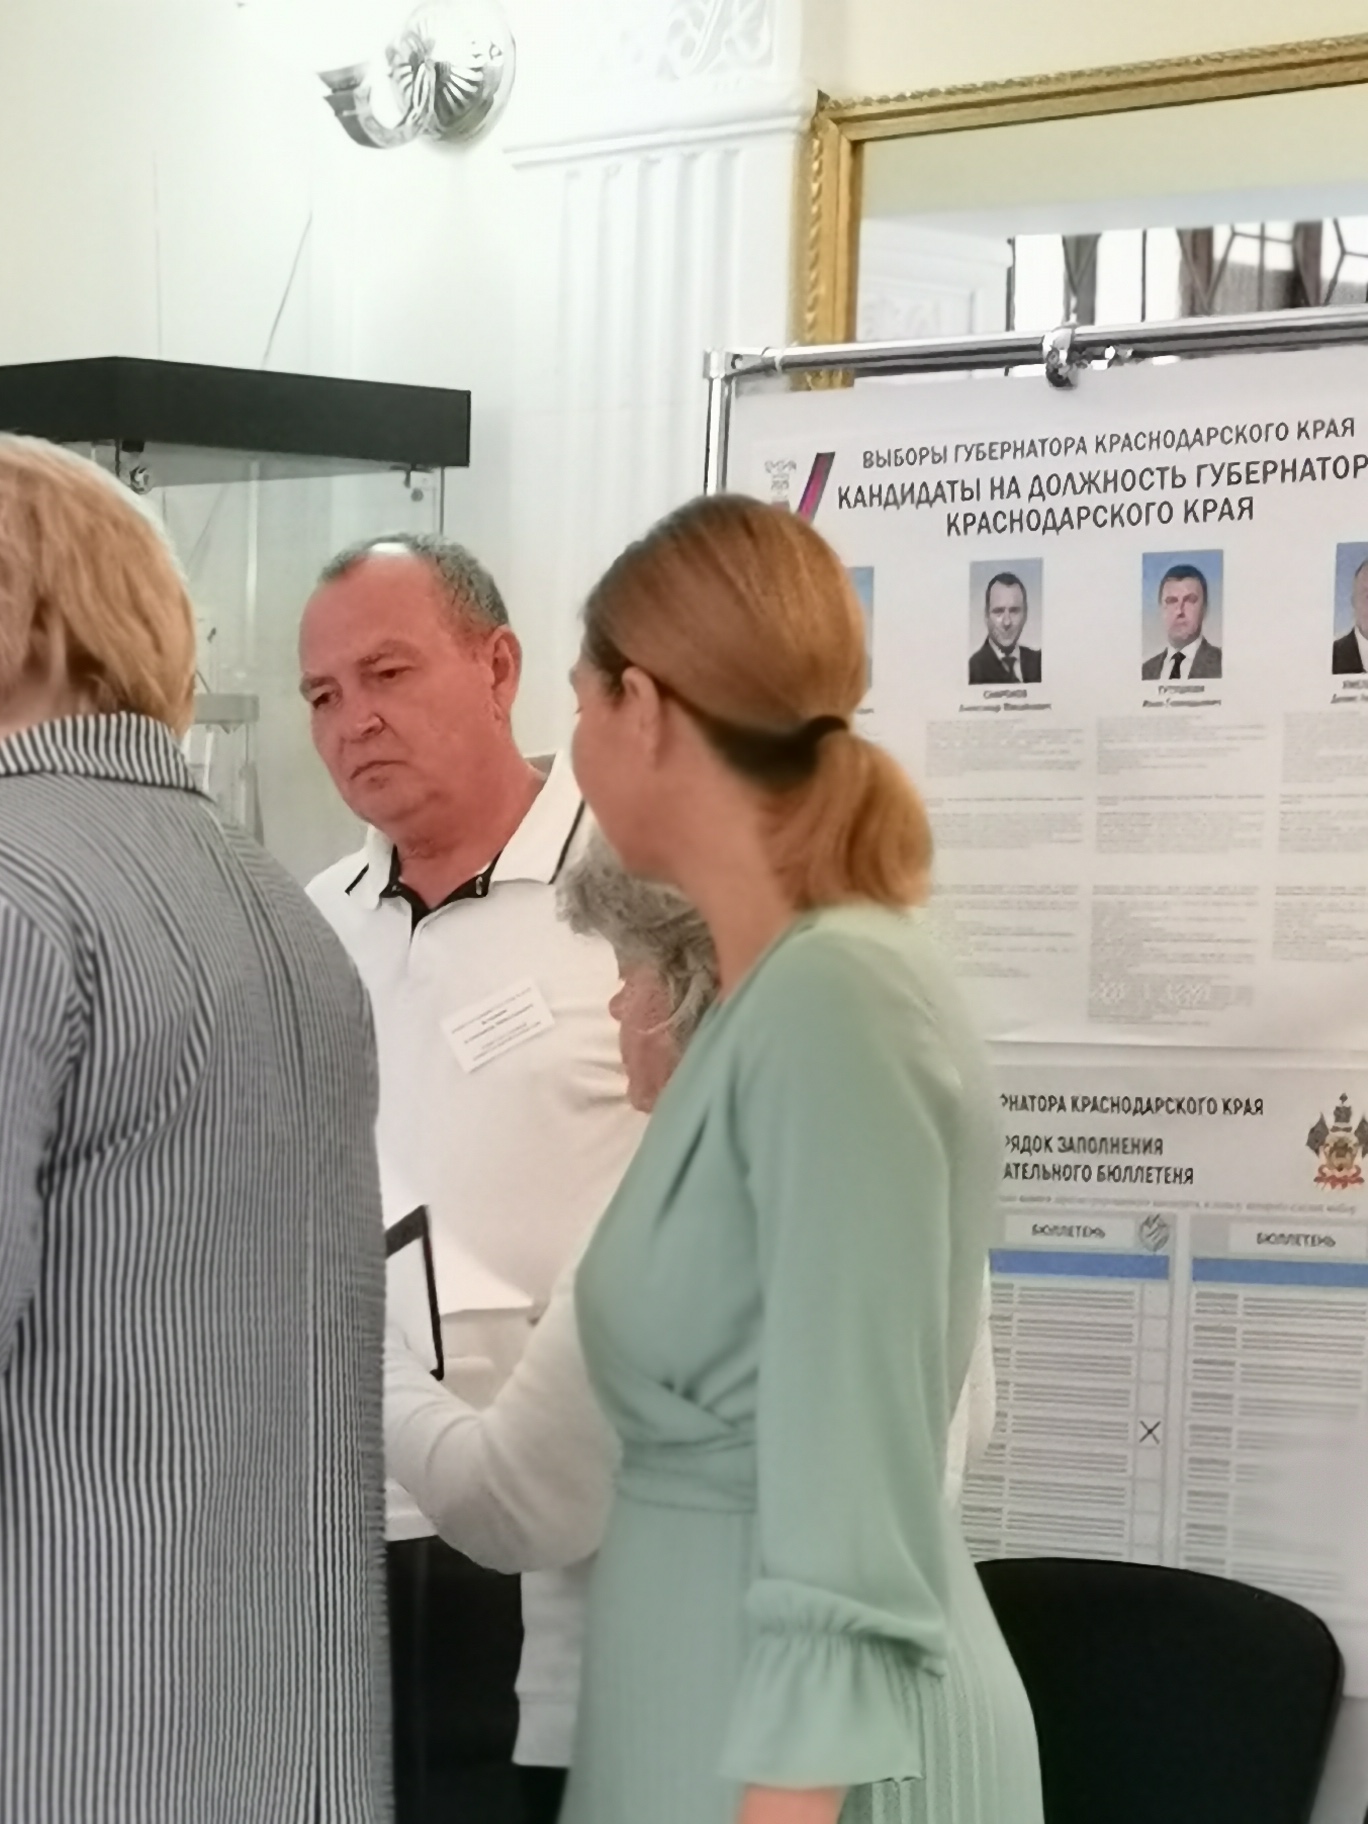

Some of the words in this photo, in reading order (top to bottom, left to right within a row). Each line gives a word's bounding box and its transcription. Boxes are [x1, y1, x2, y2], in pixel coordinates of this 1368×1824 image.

[862, 444, 948, 469] ВЫБОРЫ
[954, 435, 1088, 463] ГУБЕРНАТОРА
[1094, 421, 1289, 454] КРАСНОДАРСКОГО
[1296, 417, 1355, 441] КРАЯ
[837, 477, 981, 511] КАНДИДАТЫ
[990, 474, 1022, 500] НА
[1028, 465, 1187, 503] ДОЛЖНОСТЬ
[946, 500, 1174, 537] КРАСНОДАРСКОГО
[1183, 496, 1254, 524] КРАЯ
[1070, 1095, 1218, 1117] КРАСНОДАРСКОГО
[1222, 1097, 1264, 1116] КРАЯ
[1057, 1135, 1164, 1156] ЗАПОЛНЕНИЯ
[1096, 1164, 1194, 1185] БЮЛЛЕТЕНЯ
